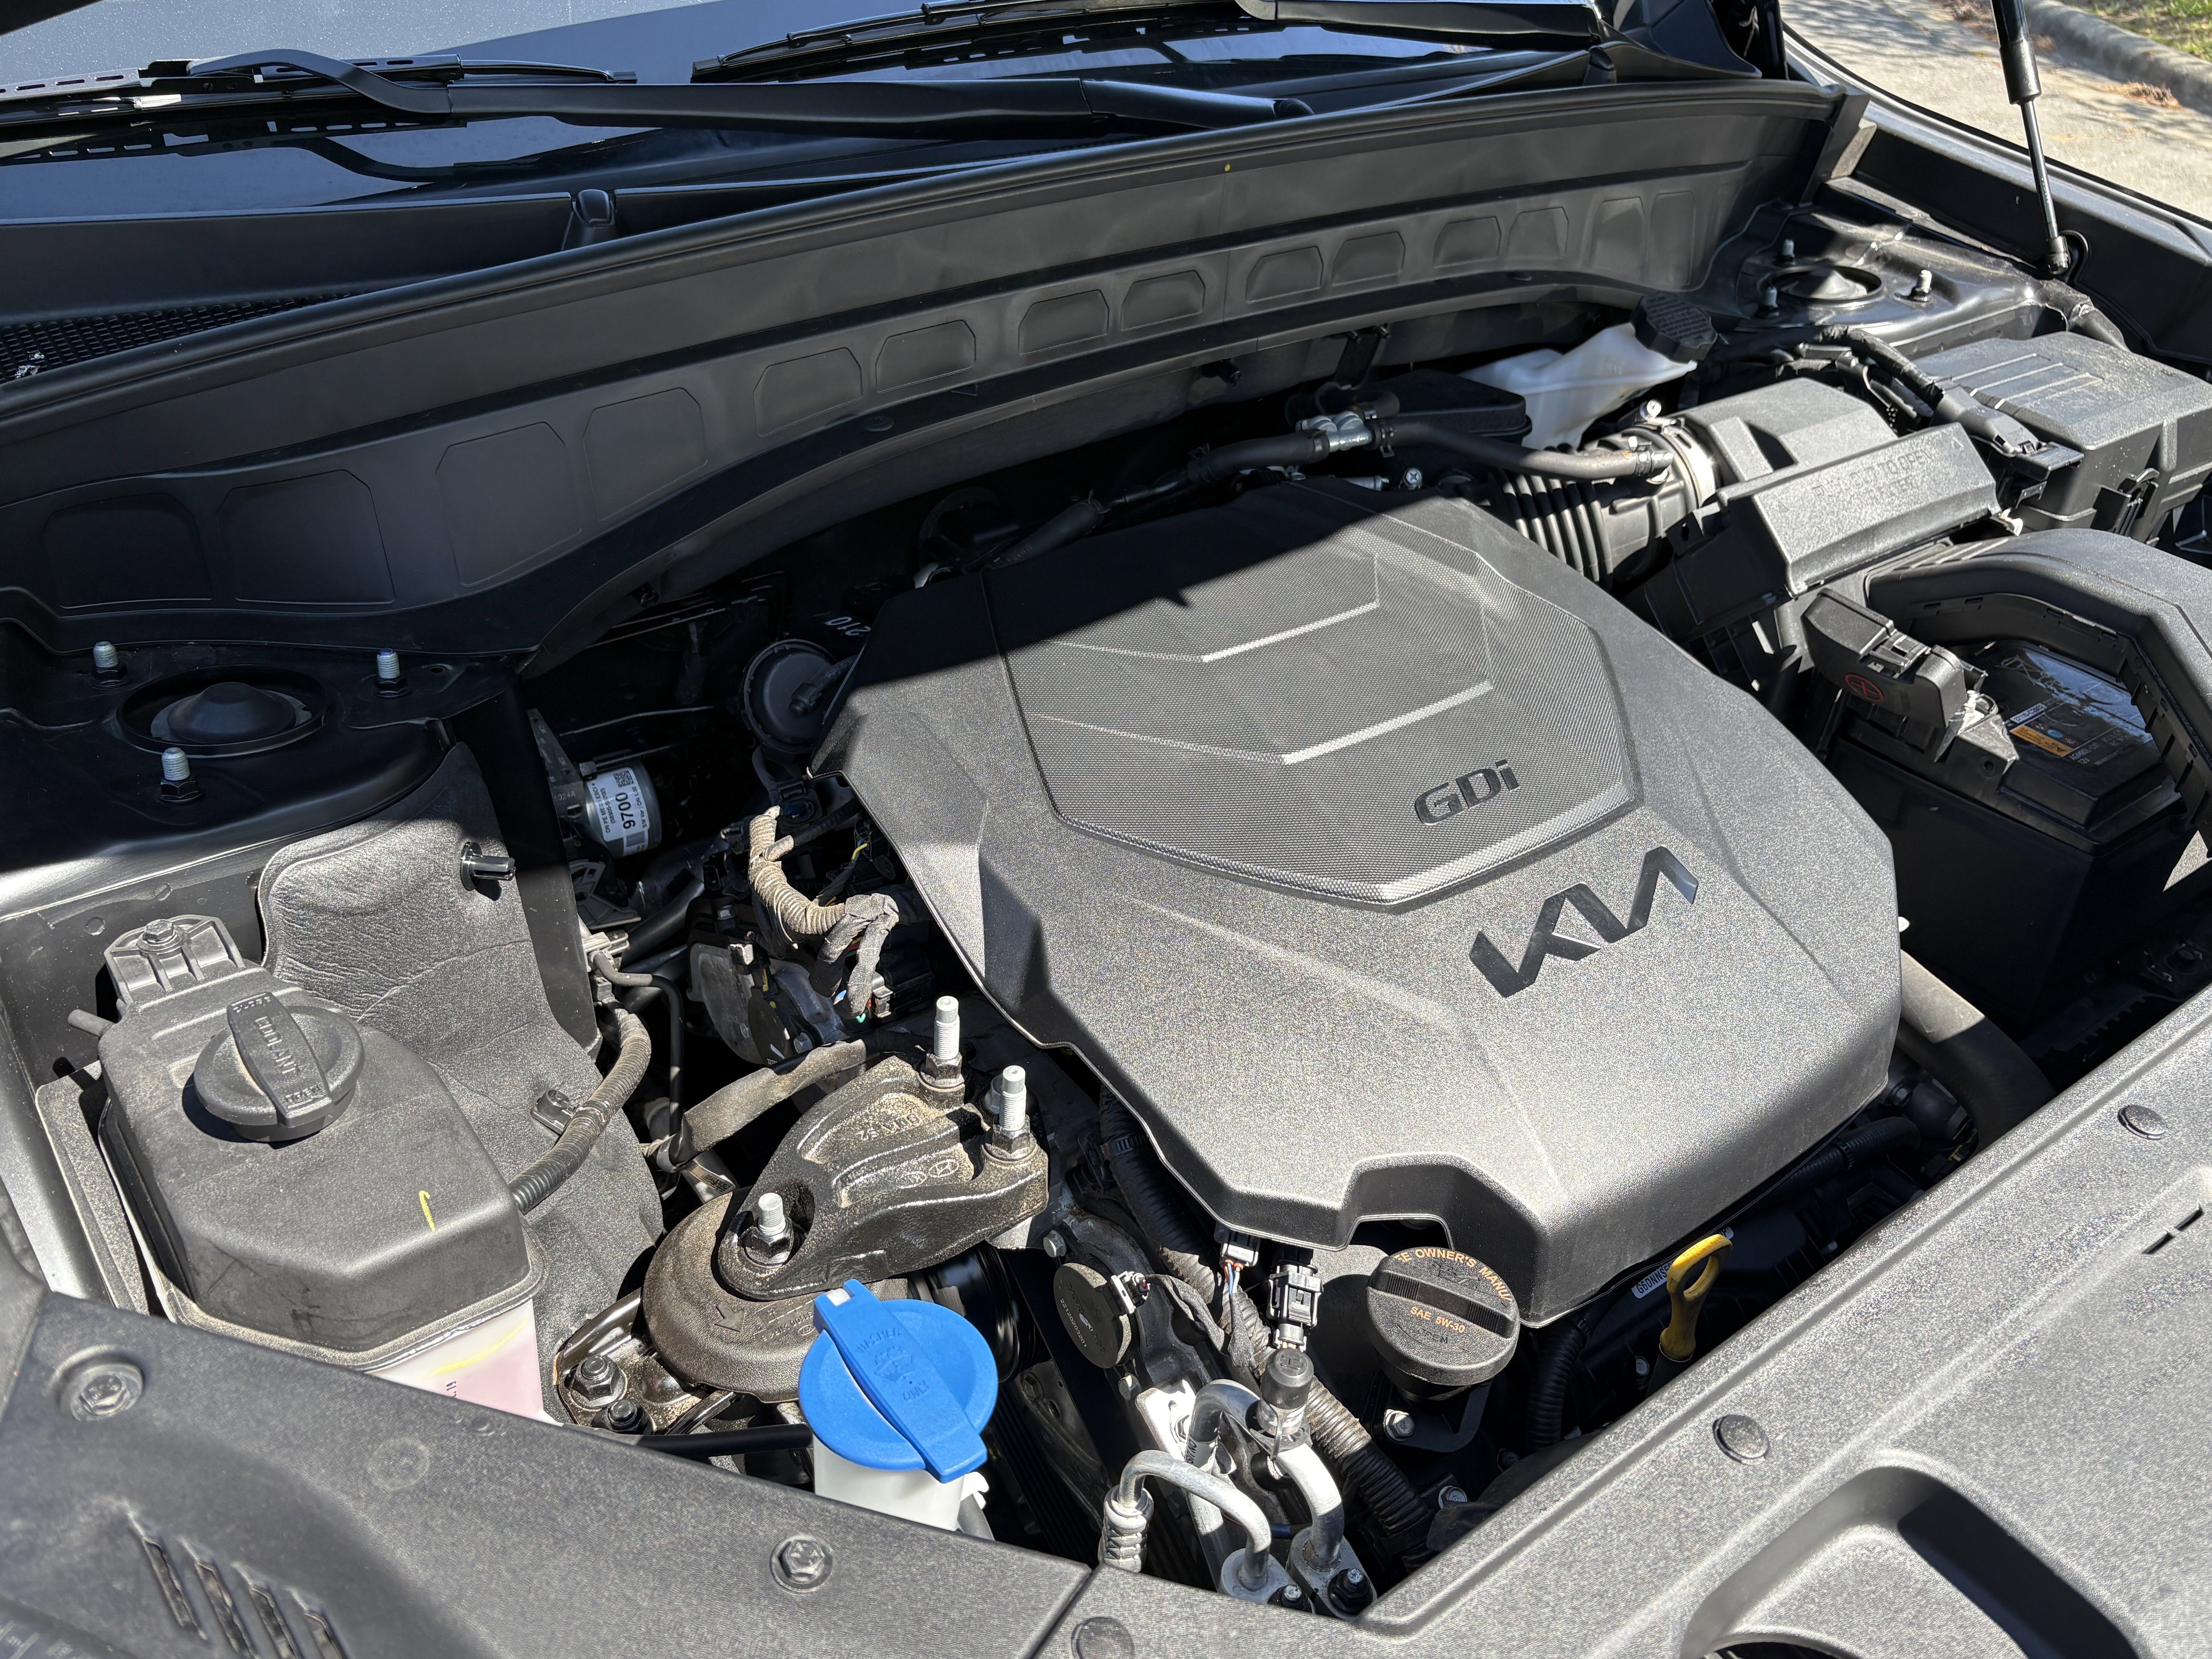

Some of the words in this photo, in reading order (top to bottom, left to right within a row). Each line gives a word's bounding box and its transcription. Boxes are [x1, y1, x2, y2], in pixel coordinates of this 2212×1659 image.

[1415, 759, 1520, 826] GDi
[615, 792, 636, 829] 9700
[1469, 846, 1698, 998] KIA
[1415, 1248, 1477, 1267] OWNER'S
[1410, 1306, 1432, 1320] SAE
[1436, 1316, 1466, 1334] 5W-30
[902, 1381, 931, 1402] ONLY
